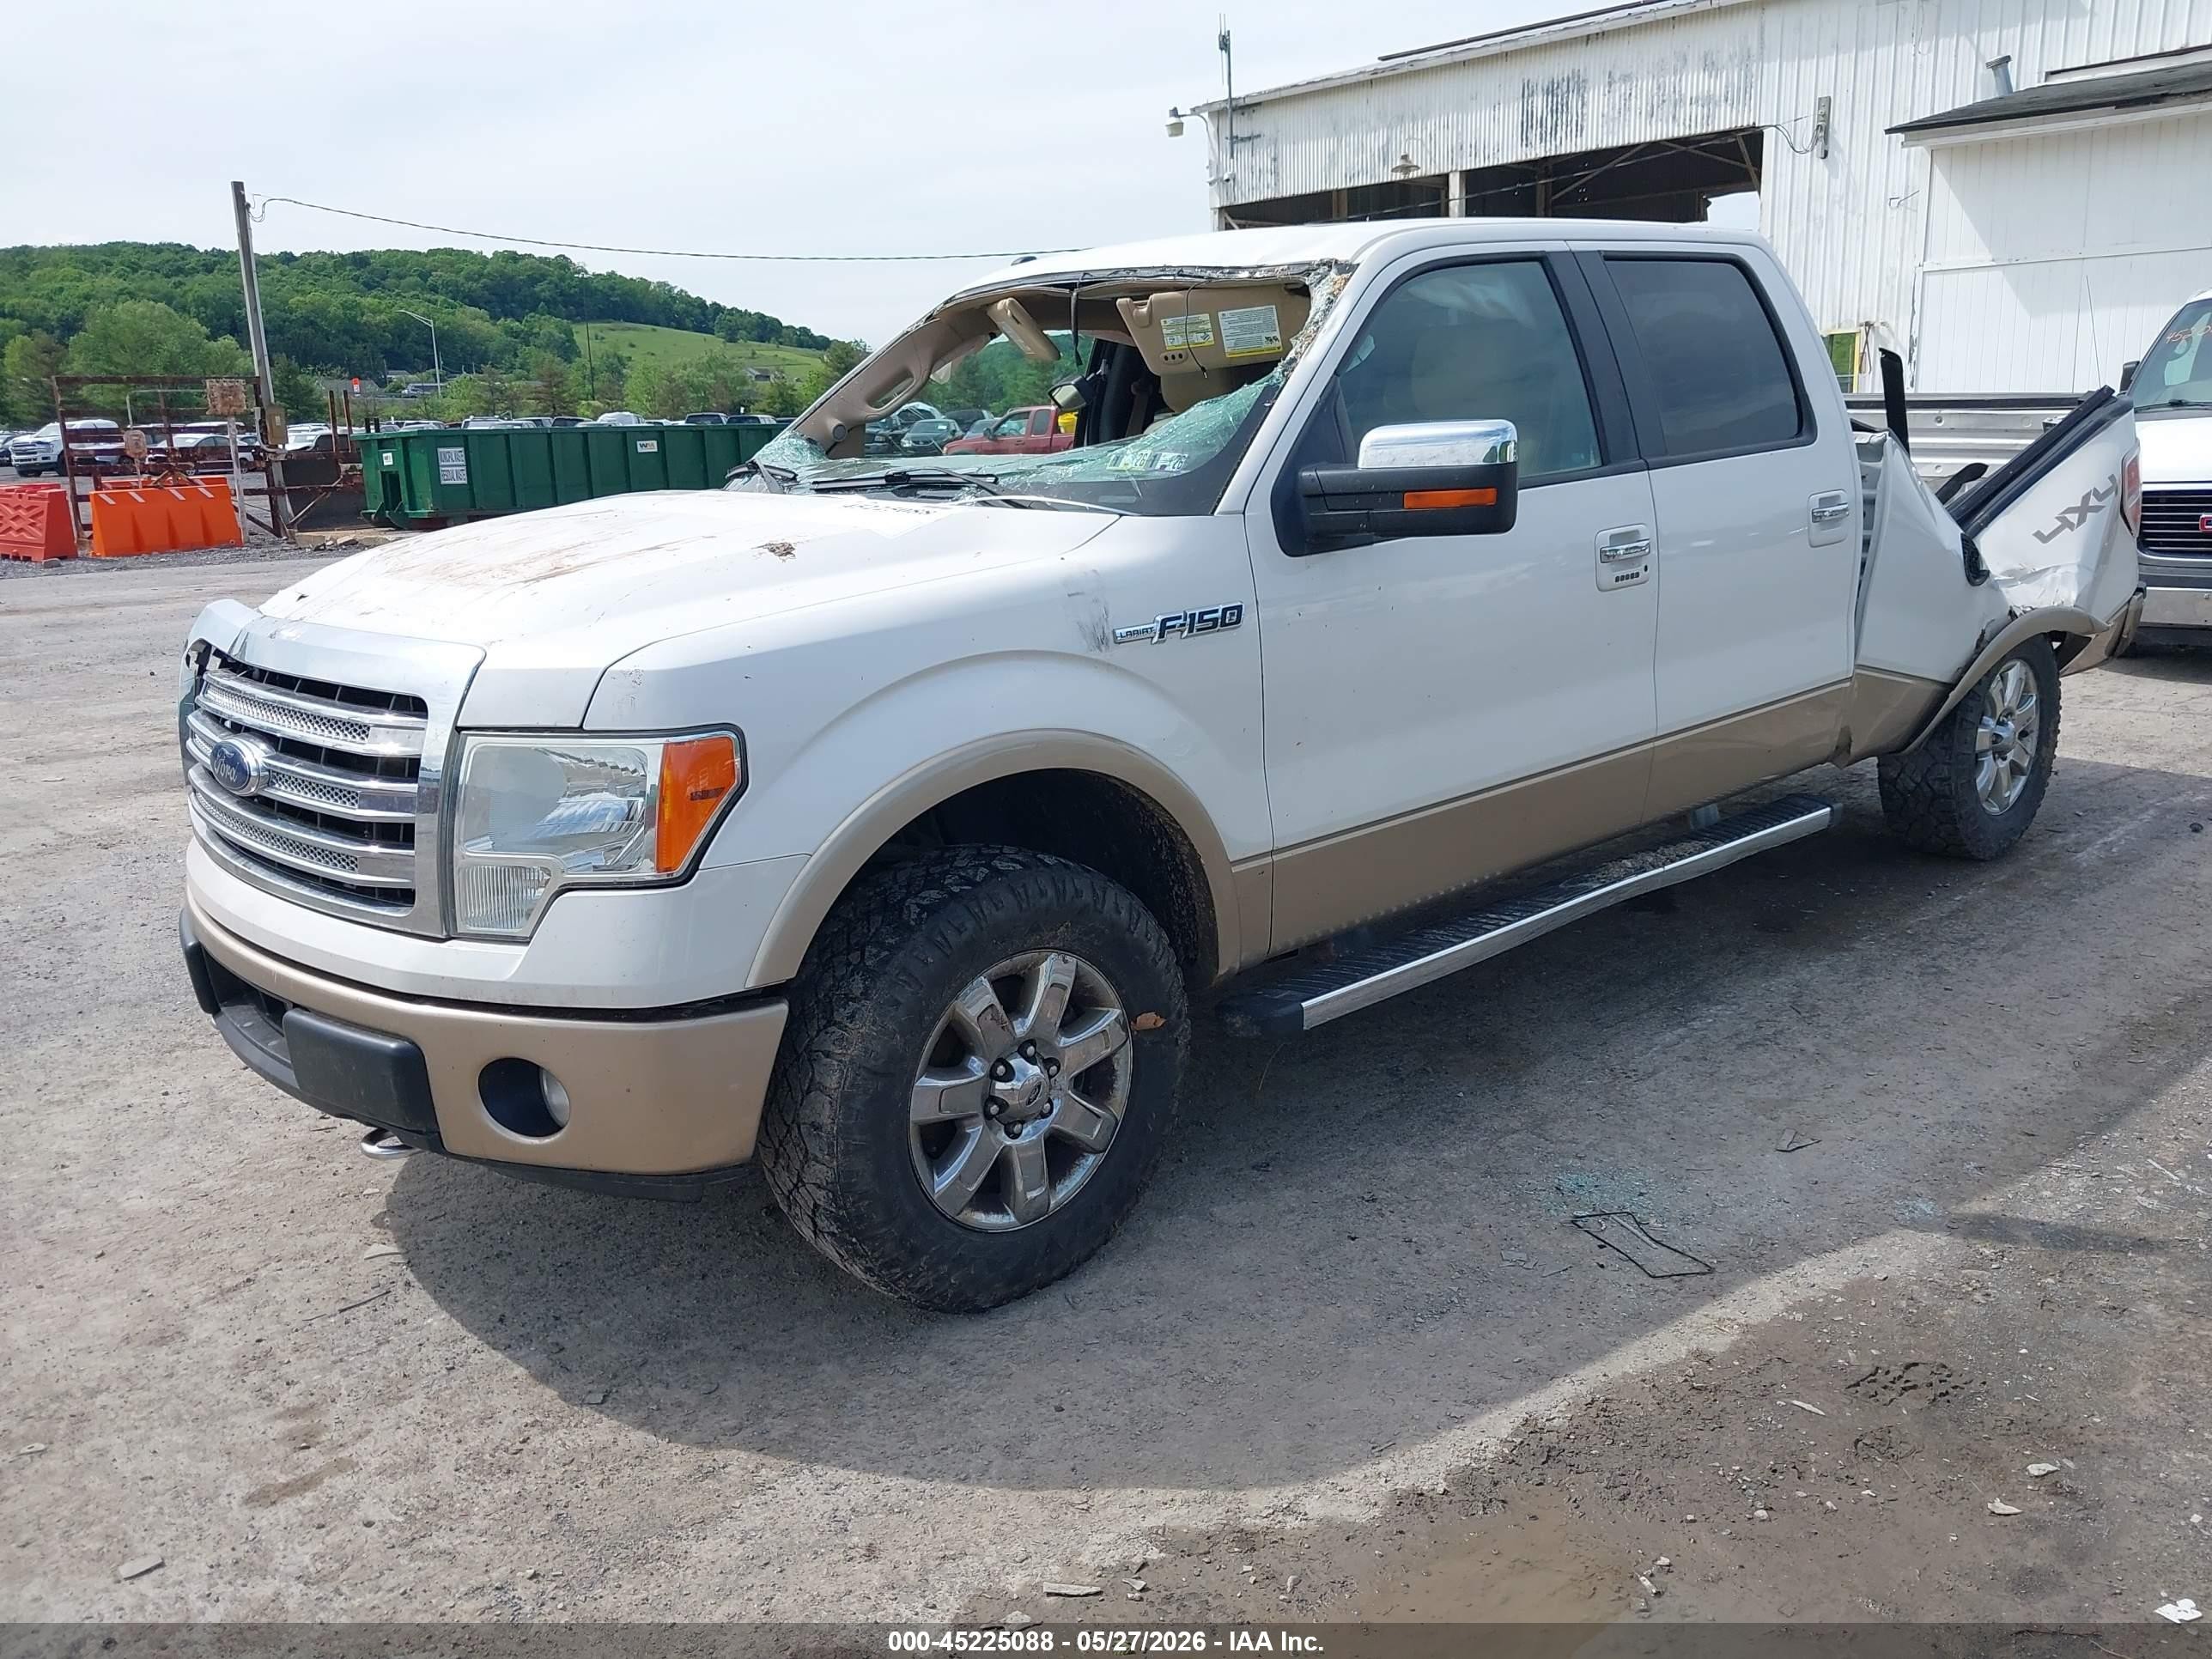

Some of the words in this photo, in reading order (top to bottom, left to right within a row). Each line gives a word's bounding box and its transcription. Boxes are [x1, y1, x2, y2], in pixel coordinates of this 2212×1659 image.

[1119, 627, 1155, 639] LARIAT
[1154, 602, 1244, 642] F-150
[213, 747, 240, 782] Ford
